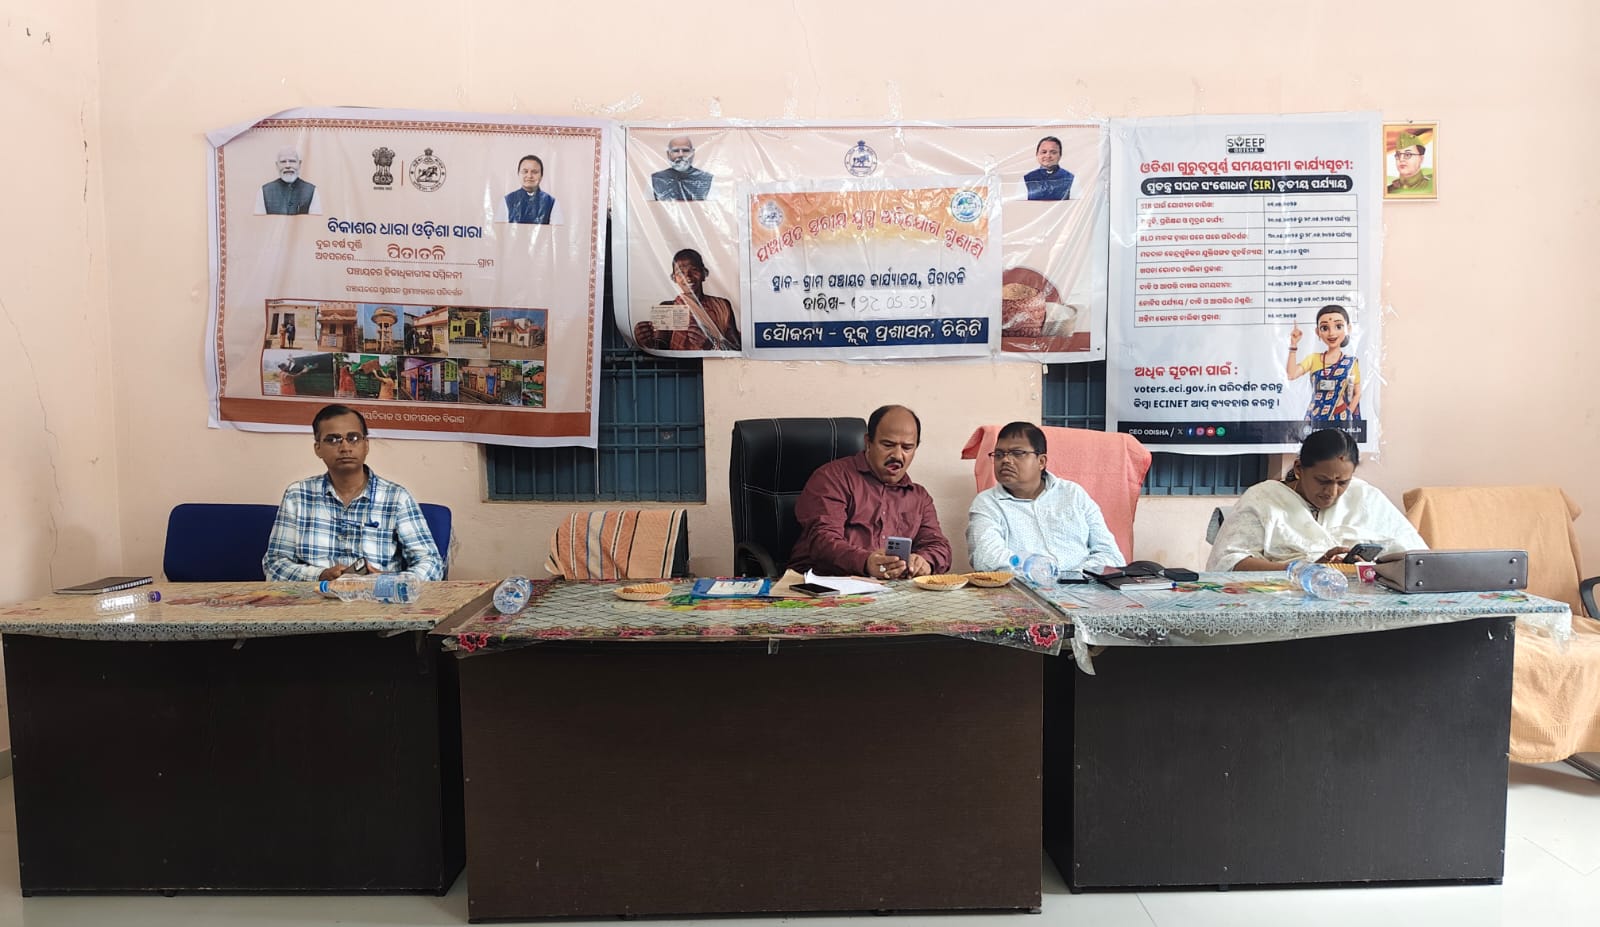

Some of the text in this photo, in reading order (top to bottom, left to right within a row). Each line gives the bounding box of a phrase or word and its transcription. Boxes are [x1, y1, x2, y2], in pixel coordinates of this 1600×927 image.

[1227, 136, 1265, 148] SWEEP
[1232, 159, 1291, 171] ସମୟସୀମା
[1249, 178, 1275, 191] (SIR)
[327, 217, 482, 239] ବିକାଶର ଧାରା ଓଡ଼ିଶା ସାରା
[756, 226, 803, 263] ପଞ୍ଚାୟତ
[387, 243, 446, 261] ପିତାତଳି
[477, 258, 495, 268] ଗ୍ରାମ
[803, 275, 823, 291] ଗ୍ରାମ
[828, 274, 865, 288] ପଞ୍ଚାୟତ
[927, 267, 967, 286] ପିତାତଳି
[762, 323, 824, 342] ସୌଜନ୍ୟ
[941, 318, 982, 338] ଚିକିଟି
[1134, 366, 1165, 380] ଅଧିକ
[1168, 365, 1202, 380] ସୂଚନା
[1134, 384, 1217, 395] voters.eci.gov.in
[1153, 399, 1189, 408] ECINET
